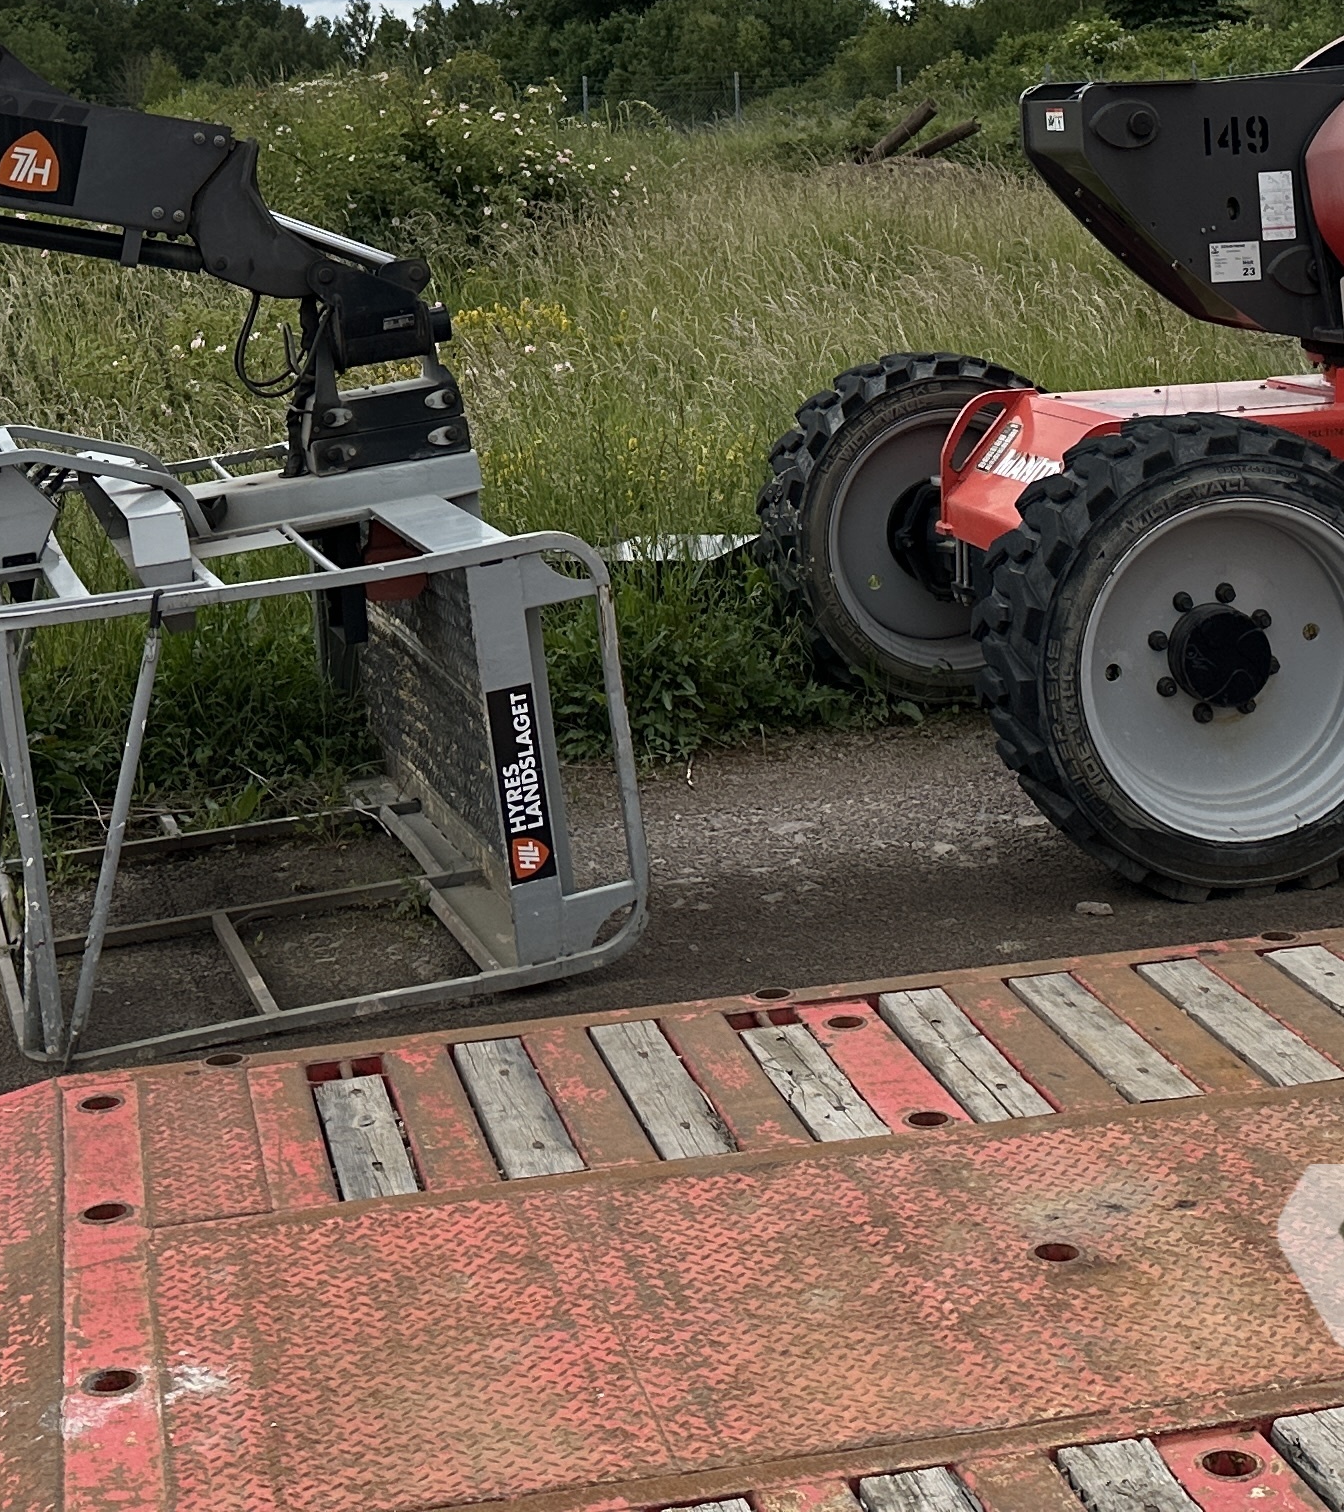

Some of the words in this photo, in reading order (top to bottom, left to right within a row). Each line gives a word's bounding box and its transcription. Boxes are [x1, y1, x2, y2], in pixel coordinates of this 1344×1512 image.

[1203, 115, 1269, 156] 149
[1242, 267, 1256, 277] 23
[509, 692, 544, 831] LANDSLAGET
[502, 763, 527, 834] HYRES
